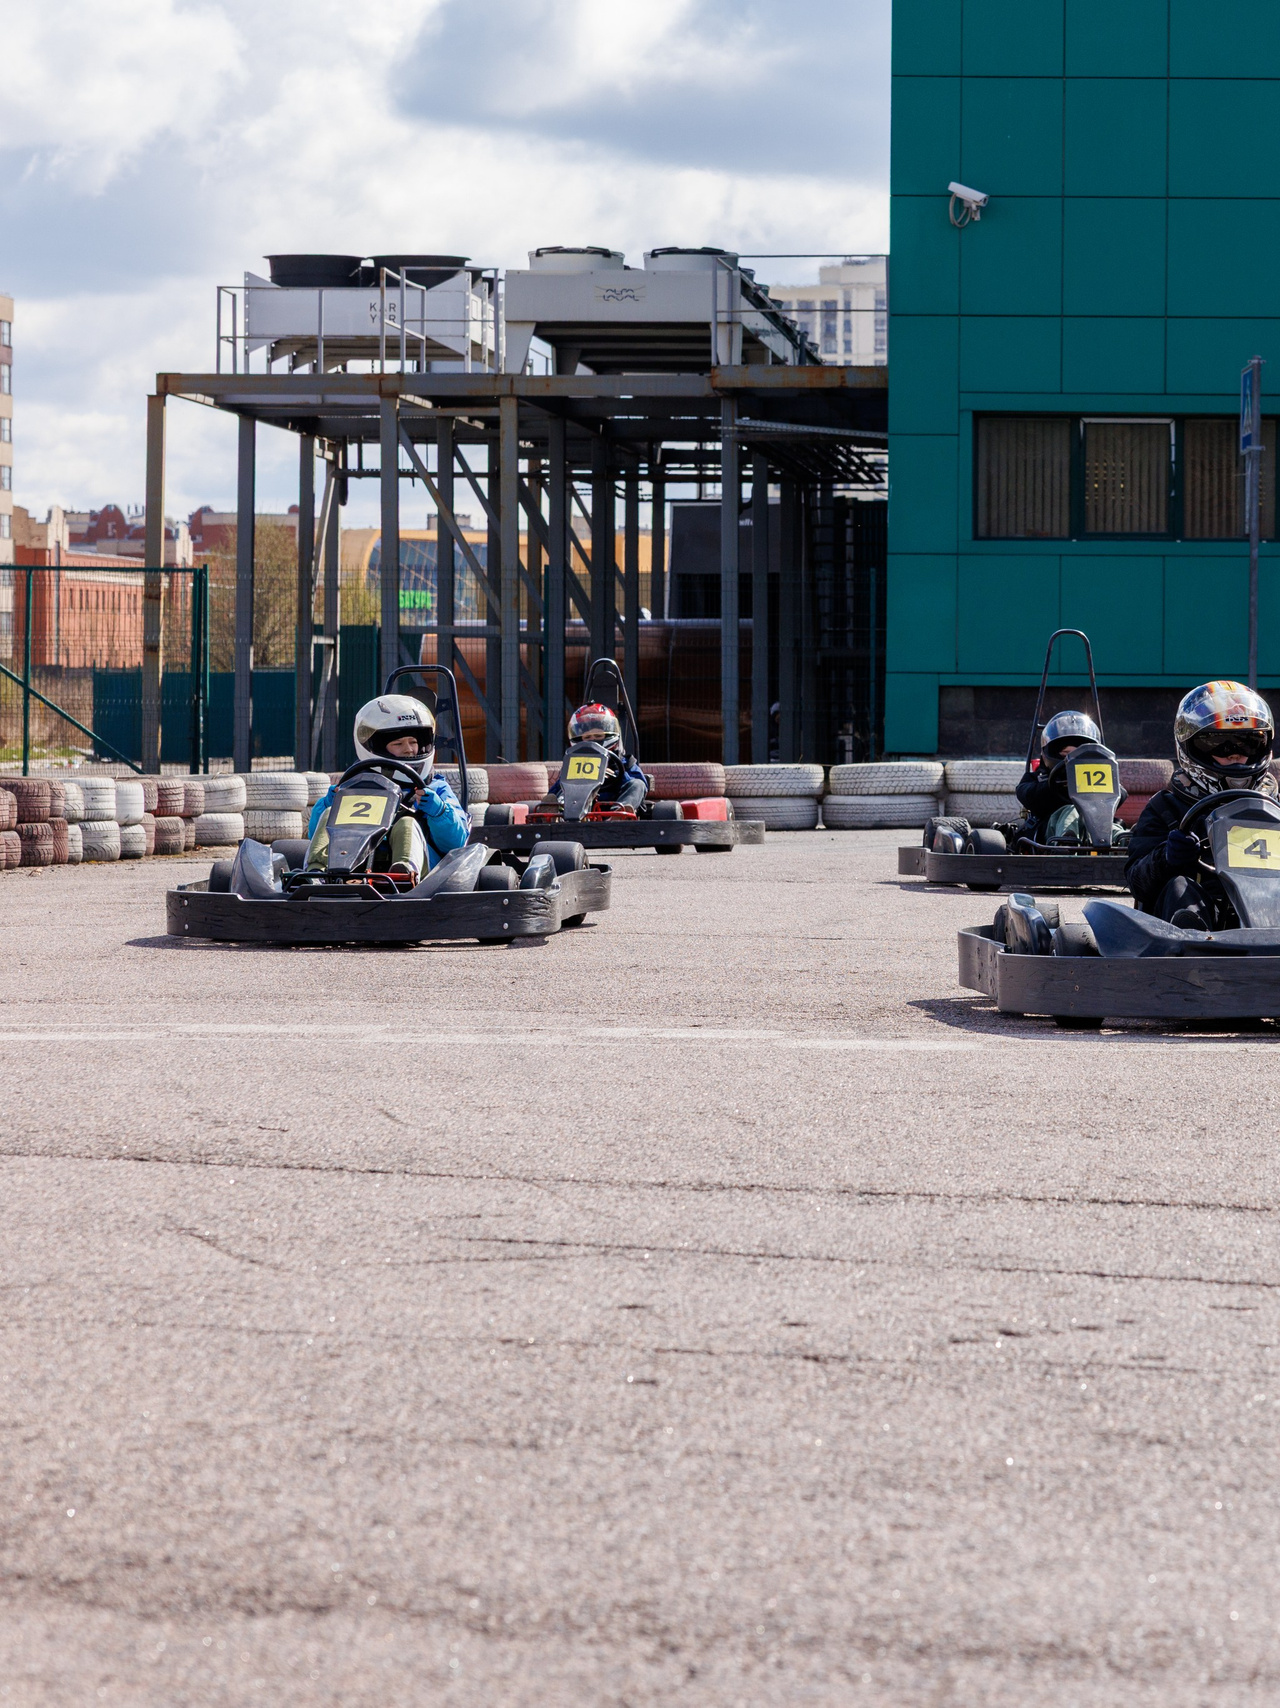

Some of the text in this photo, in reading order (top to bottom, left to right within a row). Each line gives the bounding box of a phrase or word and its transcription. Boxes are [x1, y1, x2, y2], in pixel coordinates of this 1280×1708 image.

[369, 302, 397, 312] KR
[369, 314, 397, 323] YR
[575, 762, 595, 774] 10
[1082, 770, 1107, 786] 12
[349, 802, 372, 818] 2
[1243, 838, 1272, 860] 4
